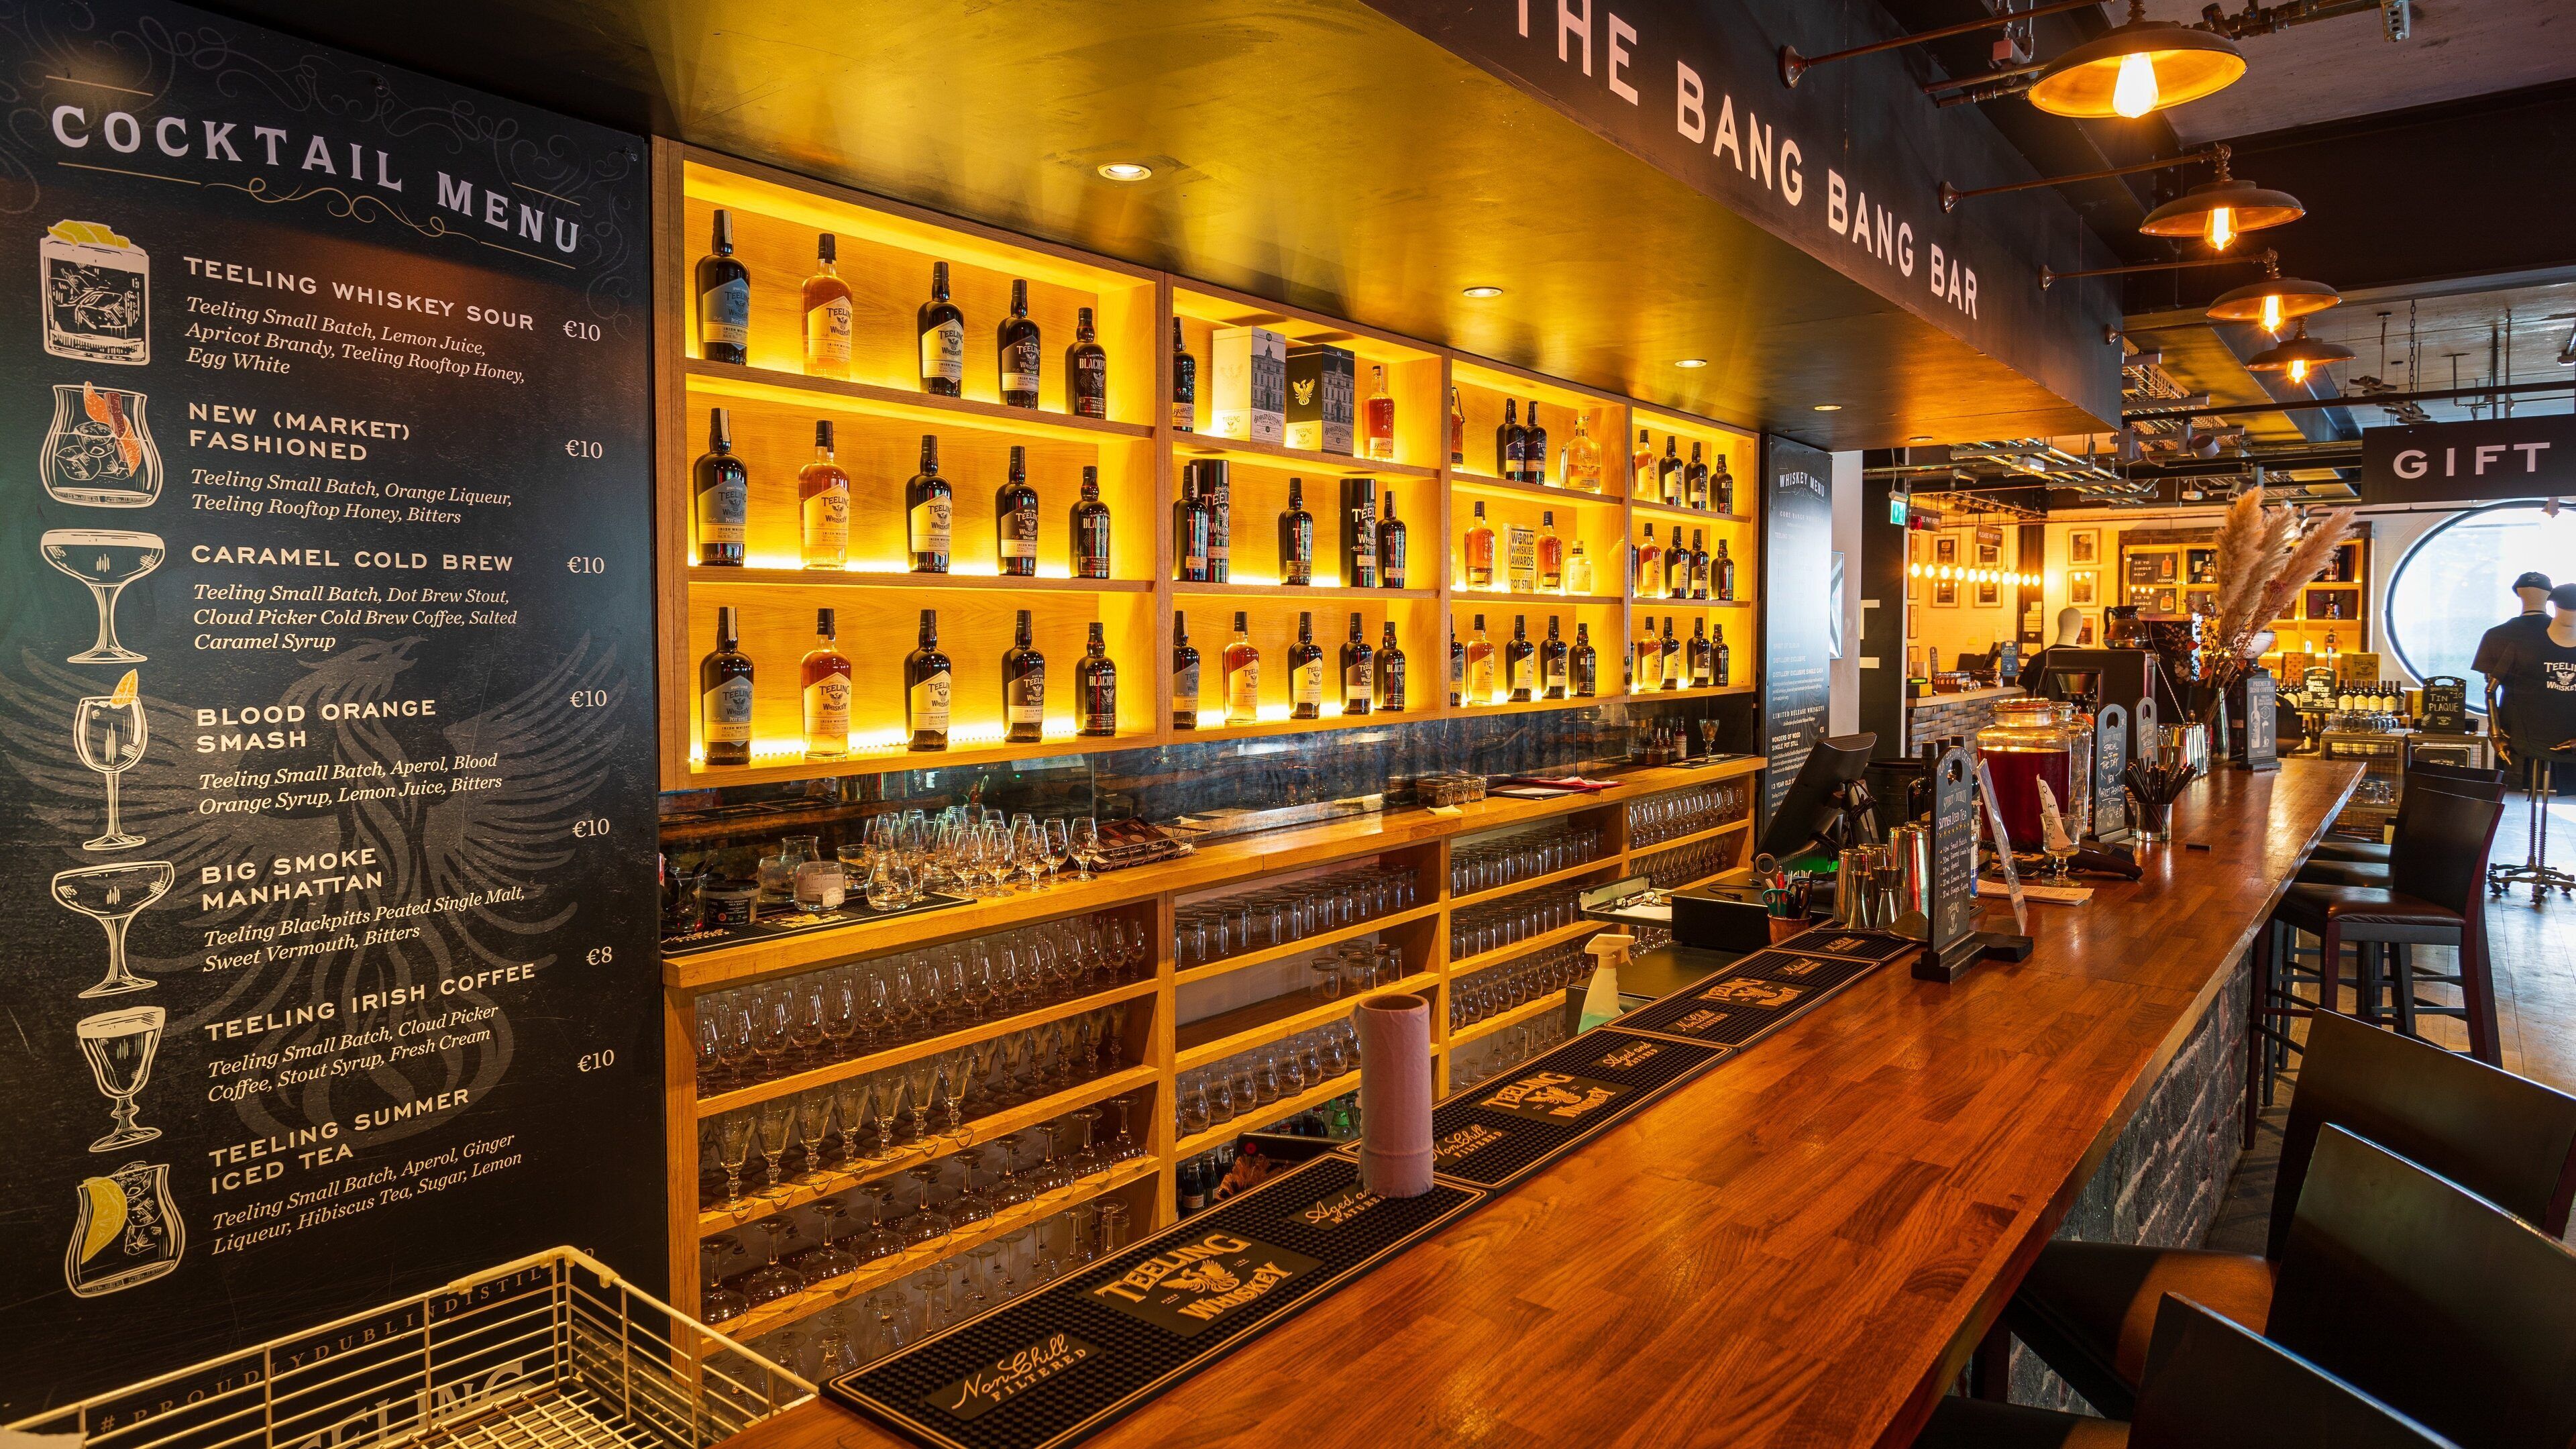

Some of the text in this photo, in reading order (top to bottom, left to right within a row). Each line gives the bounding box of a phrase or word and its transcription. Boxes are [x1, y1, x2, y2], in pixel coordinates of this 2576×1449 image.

[52, 105, 580, 254] COCKTAIL MENU
[1677, 60, 1803, 207] BANG
[1828, 169, 1913, 277] BANG
[1931, 243, 1978, 321] BAR
[183, 256, 533, 331] TEELING WHISKEY SOUR
[186, 296, 486, 357] Teeling Small Batch, Lemon Juice,
[562, 320, 601, 341] €10
[184, 322, 525, 384] Apricot Brandy, Teeling Rooftop Honey,
[185, 347, 290, 374] Egg White
[941, 347, 961, 356] WHISKEY
[1020, 361, 1039, 370] WHISKEY
[189, 402, 409, 441] NEW (MARKET)
[190, 429, 367, 461] FASHIONED
[565, 439, 603, 459] €10
[2393, 442, 2551, 480] GIFT
[191, 468, 511, 507] Teeling Small Batch, Orange Liqueur,
[1779, 472, 1825, 497] WHISKEY MENU
[191, 494, 462, 524] Teeling Rooftop Honey, Bitters
[825, 515, 847, 524] WHISKEY
[1511, 532, 1534, 545] WORLD
[1511, 545, 1534, 555] WHISKIES
[191, 545, 513, 572] CARAMEL COLD BREW
[567, 556, 605, 574] €10
[1511, 555, 1534, 566] AWARDS
[194, 584, 509, 605] Teeling Small Batch, Dot Brew Stout,
[1511, 579, 1534, 590] POT STILL
[193, 608, 518, 628] Cloud Picker Cold Brew Coffee, Salted
[194, 633, 336, 652] Caramel Syrup
[569, 690, 607, 708] €10
[722, 690, 752, 701] TEELING
[819, 684, 850, 696] TEELING
[2430, 694, 2448, 702] TIN
[197, 699, 436, 727] BLOOD ORANGE
[727, 707, 749, 716] WHISKEY
[822, 703, 847, 712] WHISKEY
[1807, 705, 1825, 714] WHISKEYS
[2428, 702, 2459, 712] PLAQUE
[196, 730, 306, 753] SMASH
[1772, 735, 1787, 743] WONDERS
[572, 818, 610, 838] €10
[202, 847, 376, 885] BIG SMOKE
[202, 871, 382, 911] MANHATTAN
[204, 885, 525, 947] Teeling Blackpitts Peated Single Malt,
[203, 926, 421, 973] Sweet Vermouth, Bitters
[586, 946, 612, 966] €8
[205, 963, 535, 1041] TEELING IRISH COFFEE
[1698, 978, 1766, 1002] TEELING
[1756, 987, 1803, 1007] WHISKEY
[577, 1049, 614, 1072] €10
[1603, 1040, 1652, 1067] Aged and
[1624, 1049, 1658, 1067] MATURED
[1480, 1072, 1576, 1110] TEELING
[1548, 1086, 1617, 1118] WHISKEY
[209, 1089, 469, 1167] TEELING SUMMER
[1453, 1131, 1502, 1159] FILTERED
[211, 1143, 354, 1194] ICED TEA
[213, 1134, 515, 1230] Teeling Small Batch, Aperol, Ginger
[211, 1154, 521, 1255] Liqueur, Hibiscus Tea, Sugar, Lemon
[1305, 1195, 1355, 1224] Aged
[1093, 1233, 1252, 1303] TEELING
[1177, 1261, 1293, 1322] WHISKEY
[990, 1348, 1087, 1403] FILTERED
